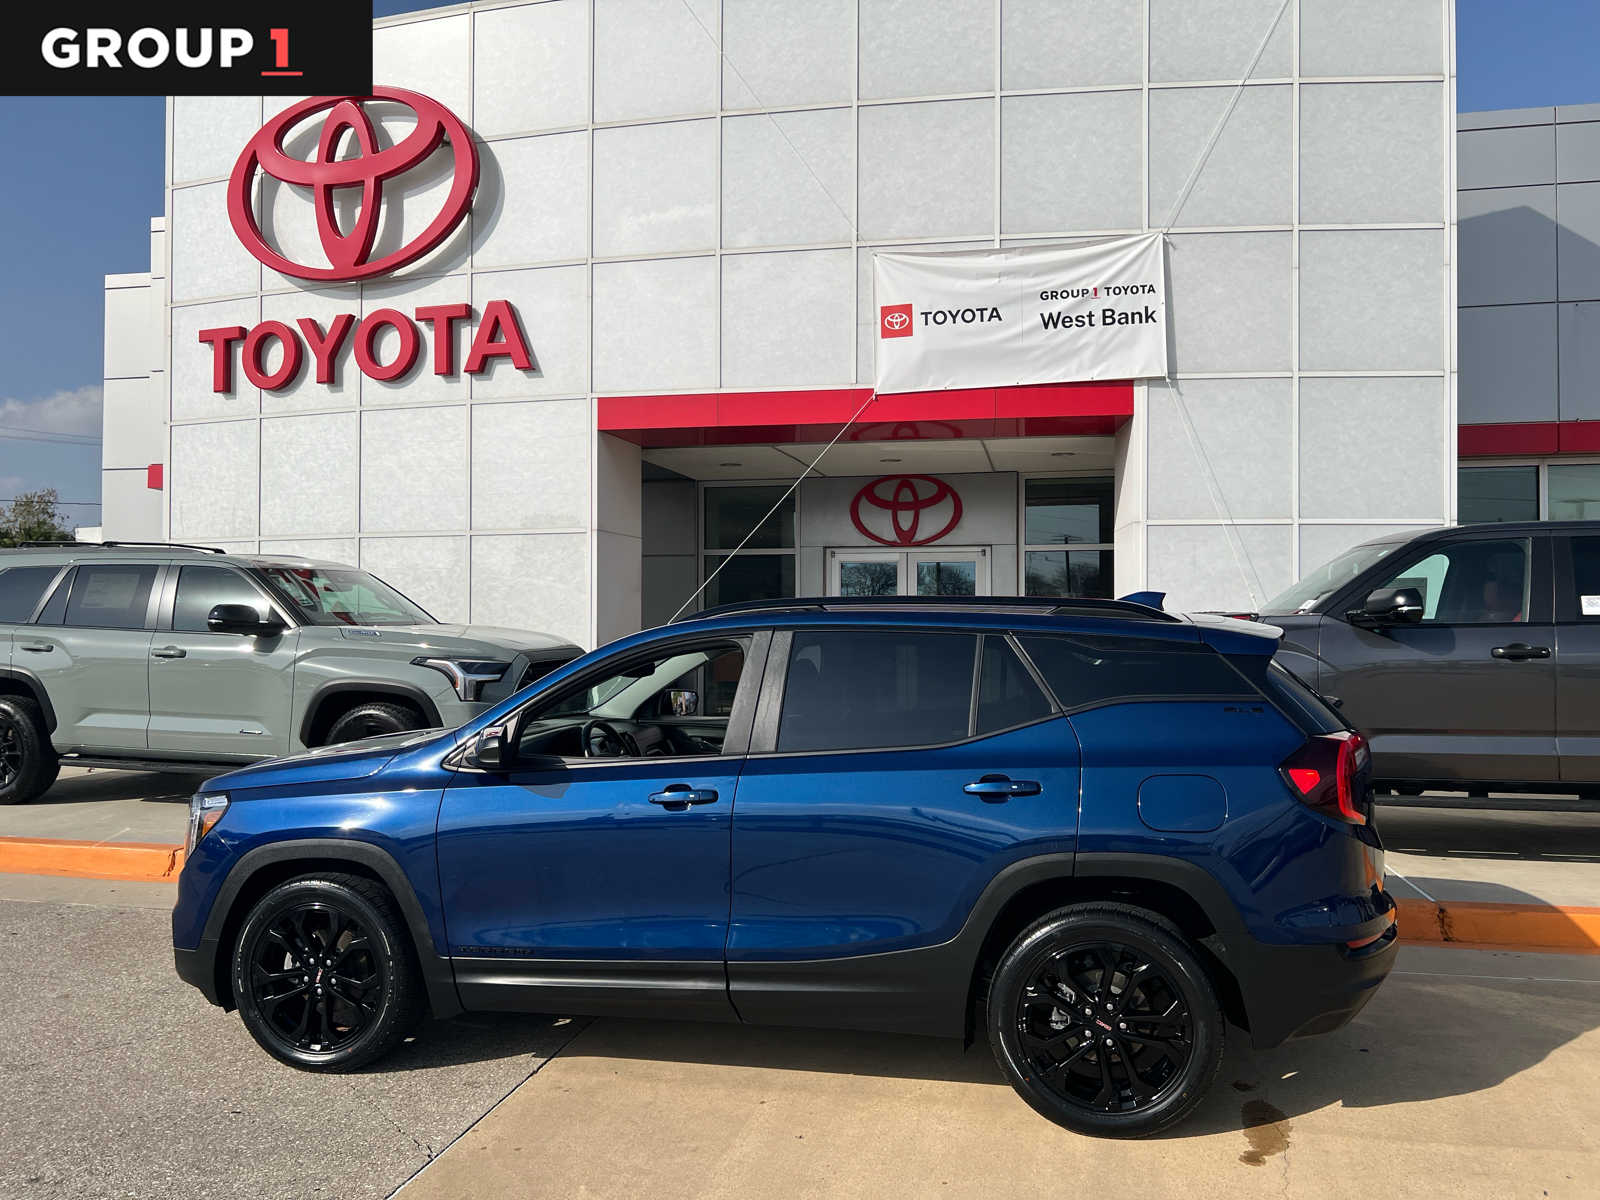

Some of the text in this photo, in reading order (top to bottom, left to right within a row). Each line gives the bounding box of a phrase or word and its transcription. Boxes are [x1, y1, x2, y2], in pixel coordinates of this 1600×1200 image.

[1040, 284, 1156, 300] GROUP 1 TOYOTA
[920, 307, 1003, 326] TOYOTA
[1040, 306, 1157, 330] West Bank
[199, 300, 535, 394] TOYOTA
